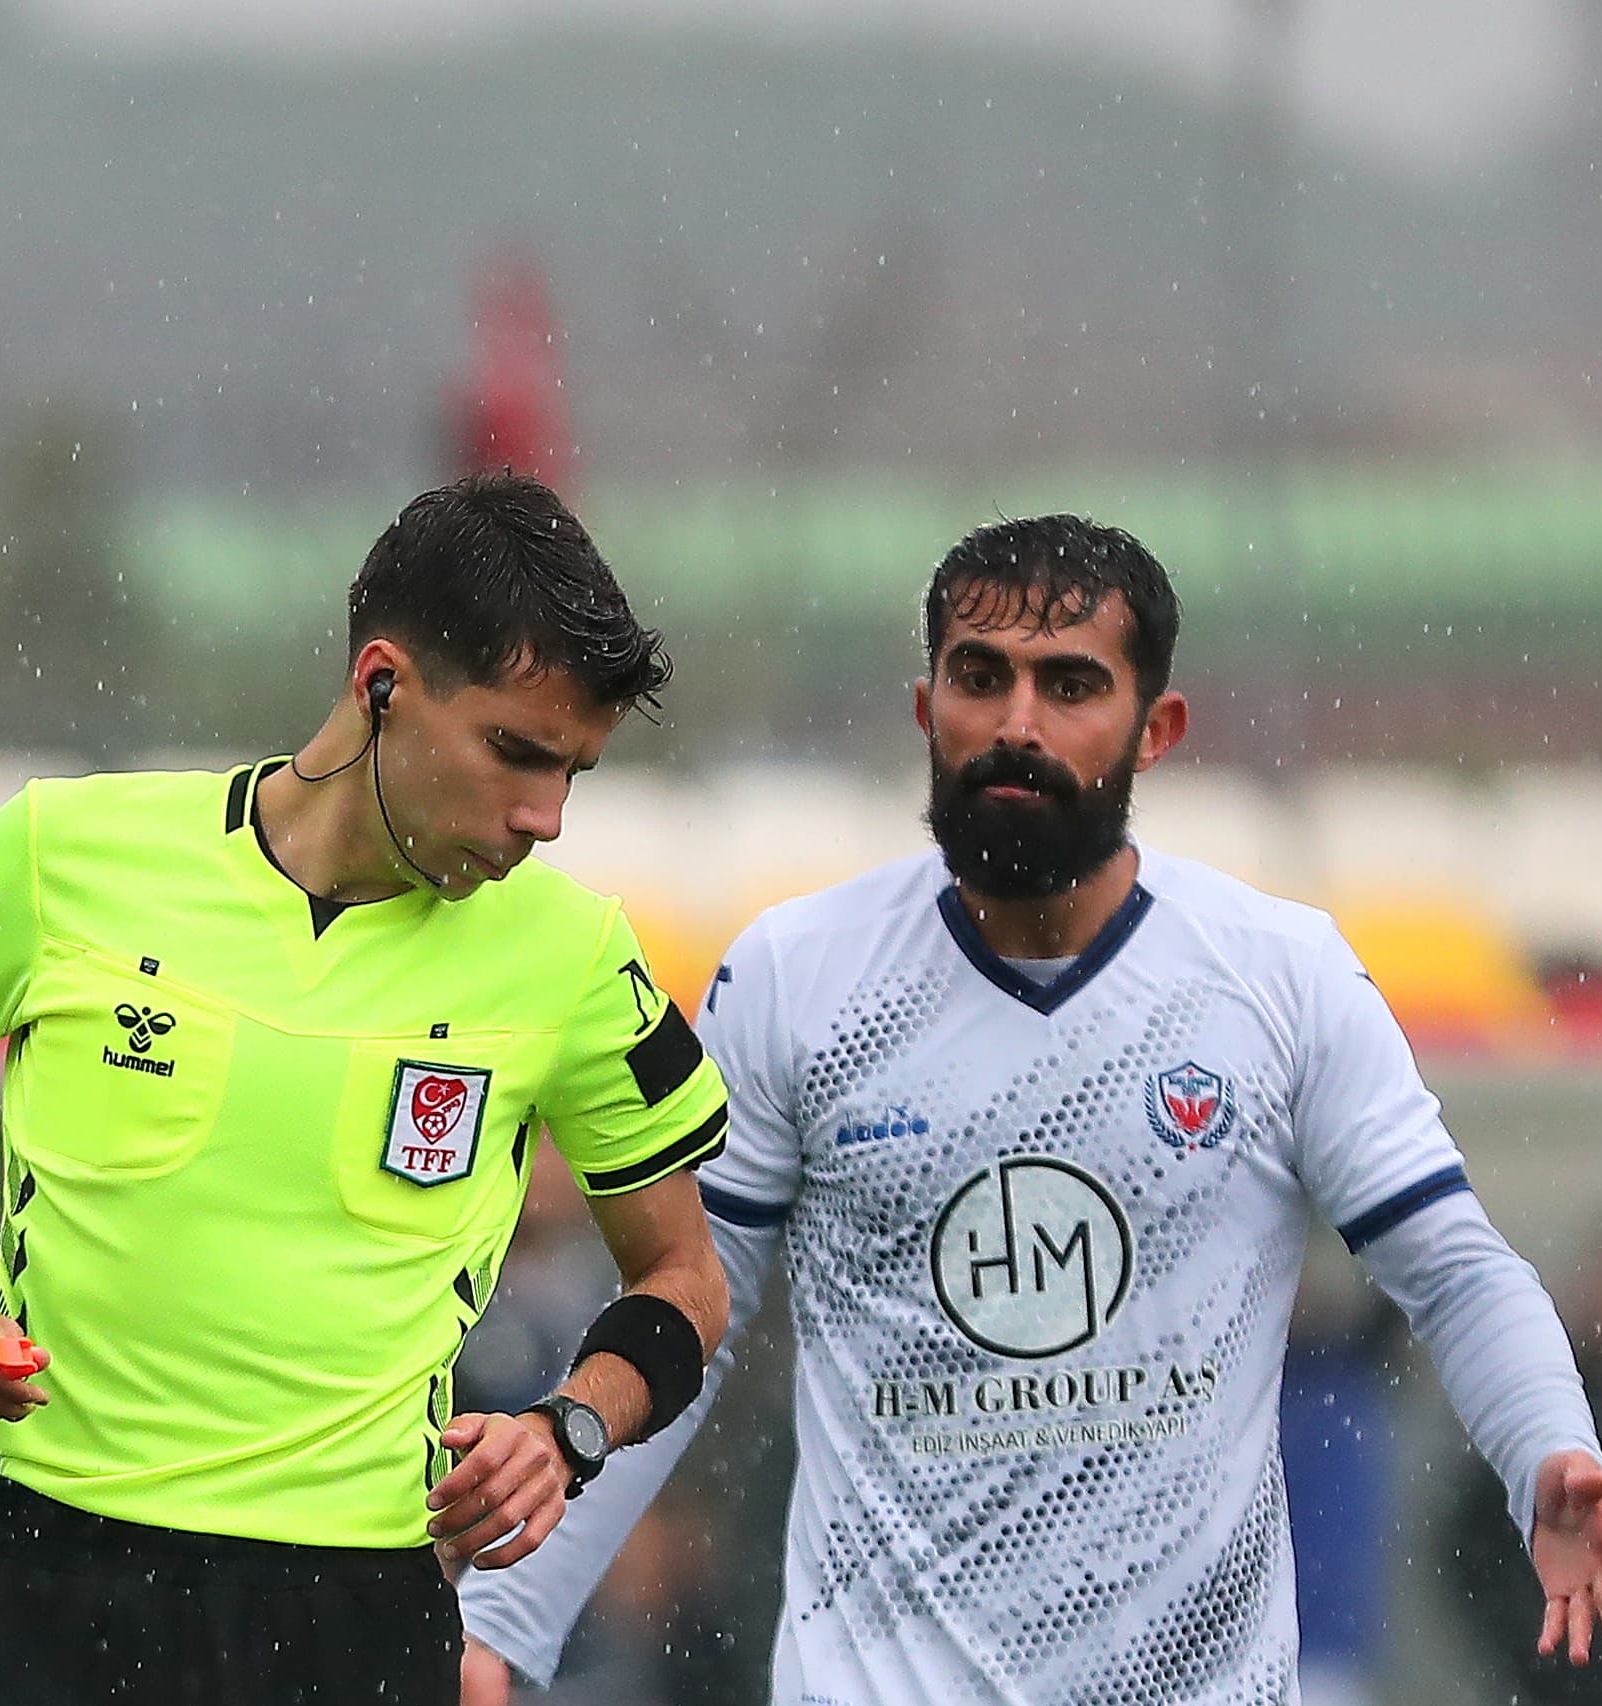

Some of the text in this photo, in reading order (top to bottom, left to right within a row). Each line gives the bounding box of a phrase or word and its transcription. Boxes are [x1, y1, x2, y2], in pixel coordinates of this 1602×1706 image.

[102, 1044, 175, 1078] hummel
[401, 1145, 457, 1173] TFF
[873, 1379, 959, 1417] H-M
[974, 1367, 1148, 1414] GROUP
